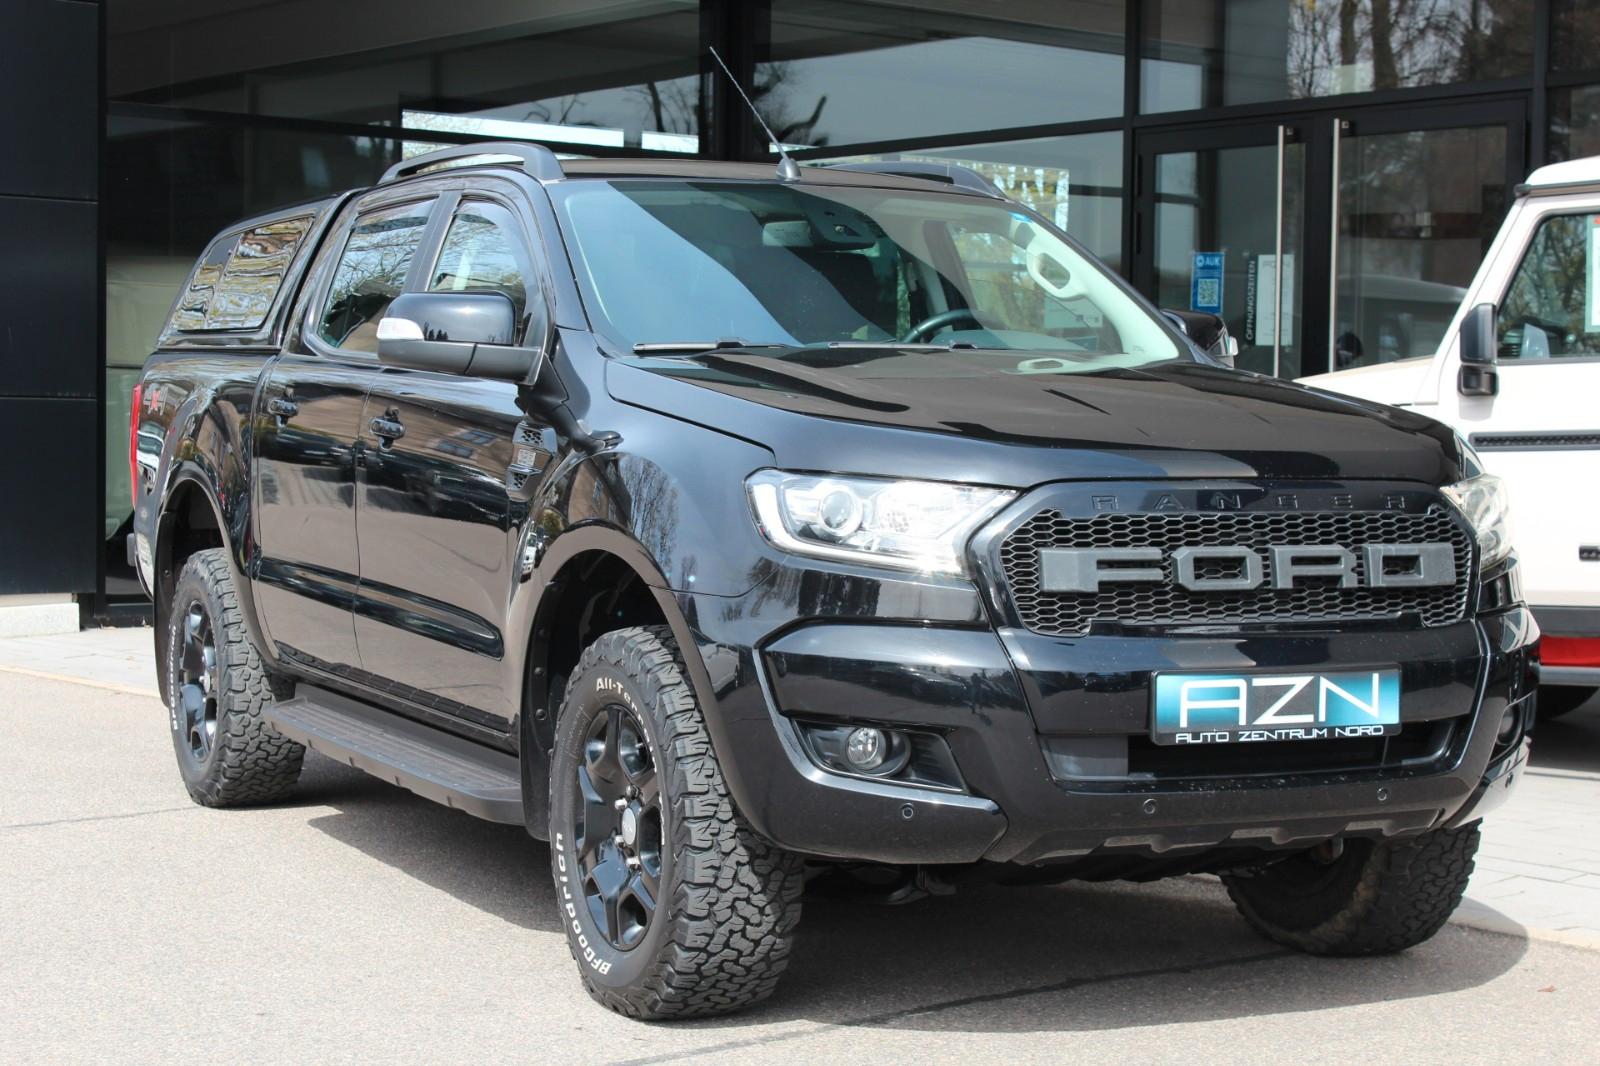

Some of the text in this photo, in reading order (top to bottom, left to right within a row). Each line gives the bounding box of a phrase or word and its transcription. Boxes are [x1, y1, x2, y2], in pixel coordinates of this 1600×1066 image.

[1038, 544, 1457, 593] FORD
[1179, 672, 1380, 728] AZN
[1175, 725, 1384, 744] AUTO ZENTRUM NORD
